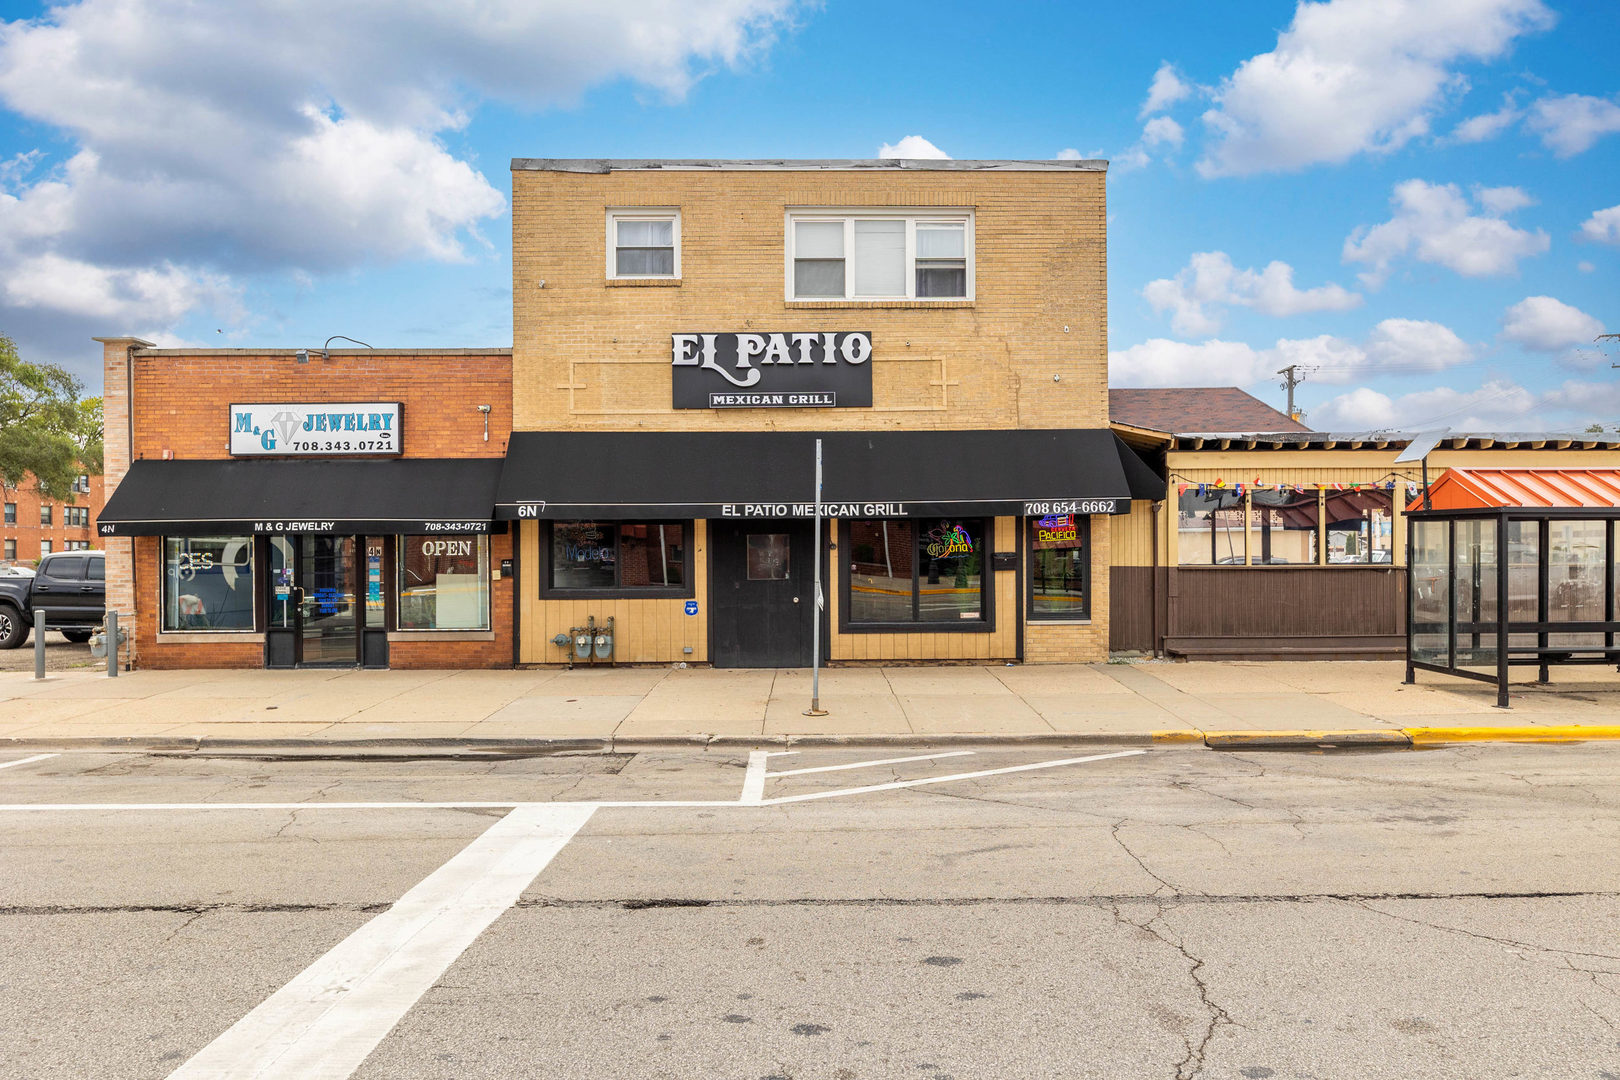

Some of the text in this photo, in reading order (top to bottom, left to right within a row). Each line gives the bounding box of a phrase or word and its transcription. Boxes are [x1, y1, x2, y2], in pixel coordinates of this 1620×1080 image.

[672, 332, 872, 387] EL PATIO
[712, 394, 833, 405] MEXICAN GRILL
[234, 413, 252, 433] M
[261, 428, 277, 450] G
[302, 412, 394, 432] JEWELRY
[293, 441, 393, 451] 708.343.0721
[518, 505, 537, 517] 6N
[722, 504, 741, 516] EL
[744, 504, 788, 516] PATIO
[863, 504, 908, 515] GRILL
[1025, 501, 1115, 514] 708 654-6662
[101, 524, 115, 533] 4N
[254, 522, 334, 531] M & G JEWELRY
[424, 522, 487, 531] 708-343-0721
[1038, 530, 1076, 542] PACIFICO
[422, 541, 472, 556] OPEN
[566, 545, 609, 560] Modelo
[926, 543, 968, 557] Corona
